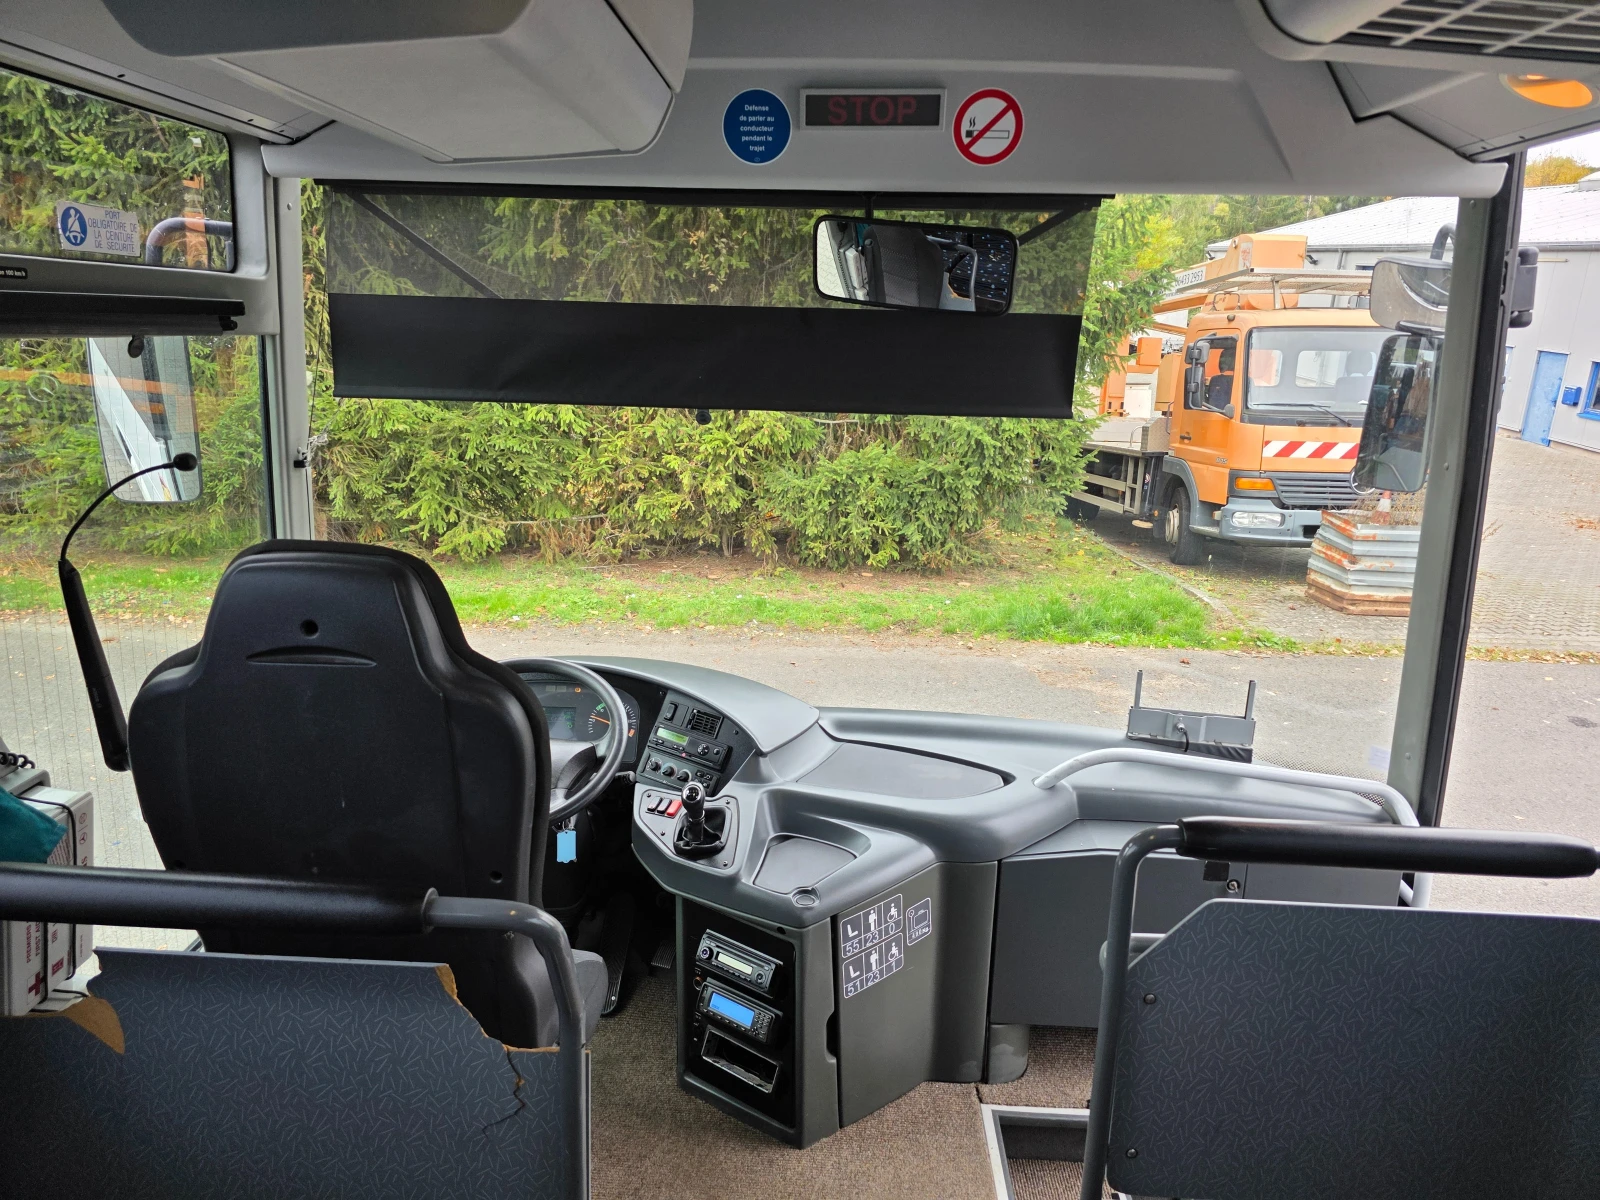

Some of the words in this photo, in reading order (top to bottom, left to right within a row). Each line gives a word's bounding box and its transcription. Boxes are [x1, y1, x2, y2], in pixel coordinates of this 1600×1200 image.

[828, 97, 917, 124] STOP
[105, 210, 120, 220] PORT
[87, 217, 127, 232] OBLIGATOIRE
[130, 223, 138, 233] DE
[94, 229, 102, 239] LA
[105, 230, 135, 243] CEINTURE
[94, 240, 103, 249] DE
[845, 940, 860, 956] 55
[866, 930, 879, 947] 23
[888, 922, 896, 934] 0
[847, 980, 860, 996] 51
[867, 970, 880, 986] 23
